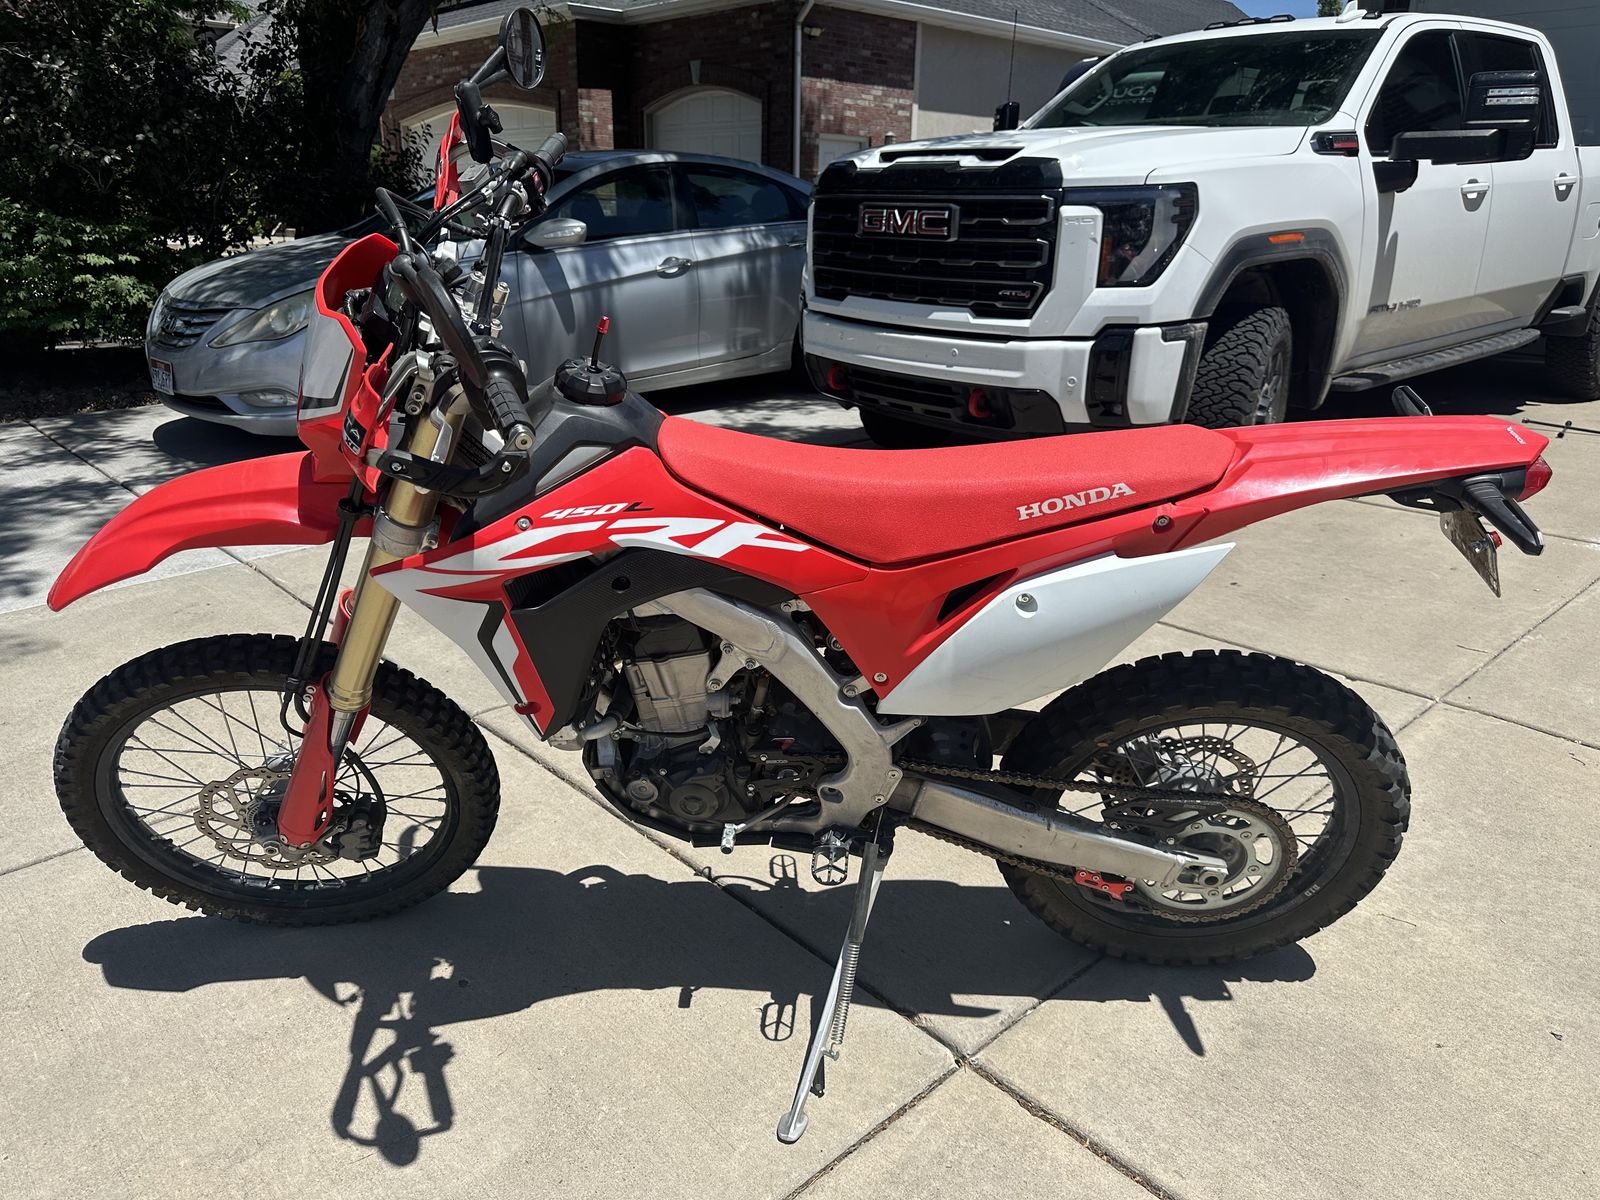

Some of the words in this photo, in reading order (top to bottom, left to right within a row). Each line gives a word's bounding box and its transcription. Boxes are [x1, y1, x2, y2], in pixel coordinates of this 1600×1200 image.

[862, 208, 950, 236] GMC
[540, 501, 655, 520] 450L
[1016, 482, 1137, 521] HONDA
[425, 516, 812, 571] CRF
